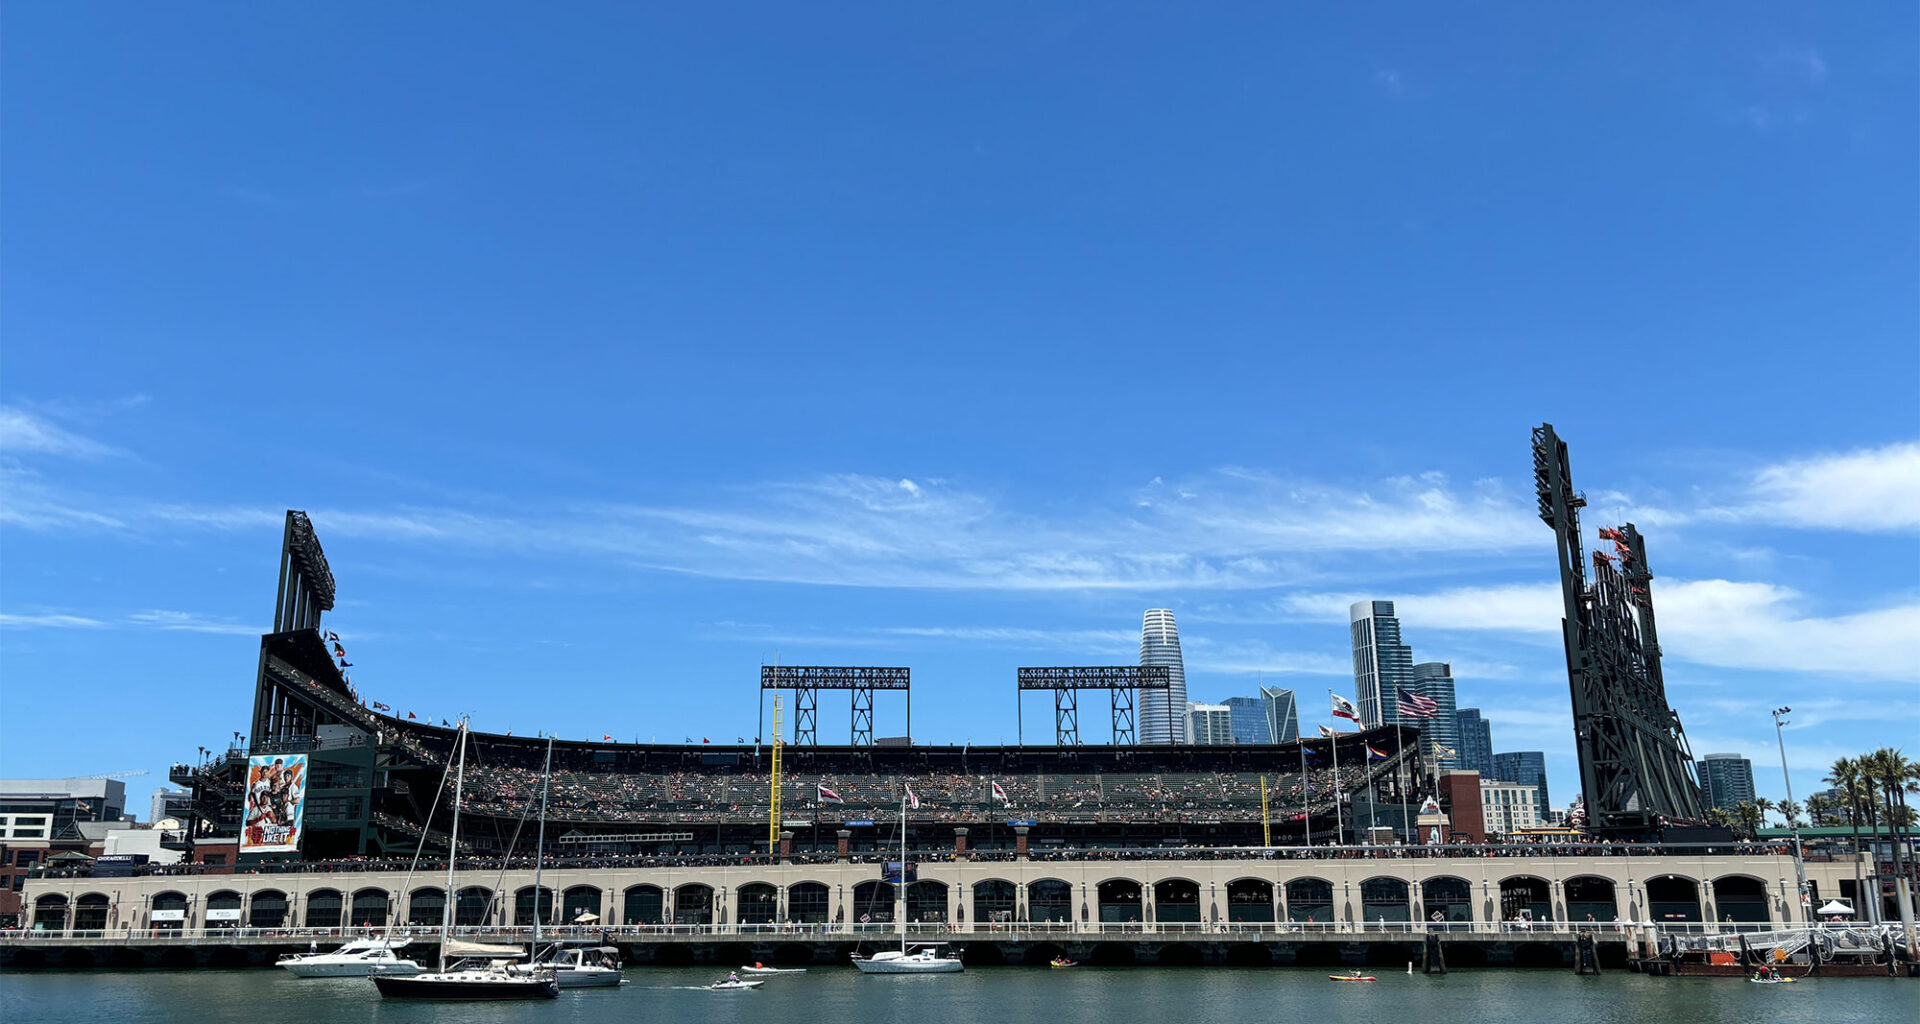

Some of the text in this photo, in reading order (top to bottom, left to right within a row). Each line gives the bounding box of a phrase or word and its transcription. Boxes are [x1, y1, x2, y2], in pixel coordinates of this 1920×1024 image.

[264, 826, 291, 834] NOTHING
[262, 832, 289, 842] LIKE IT
